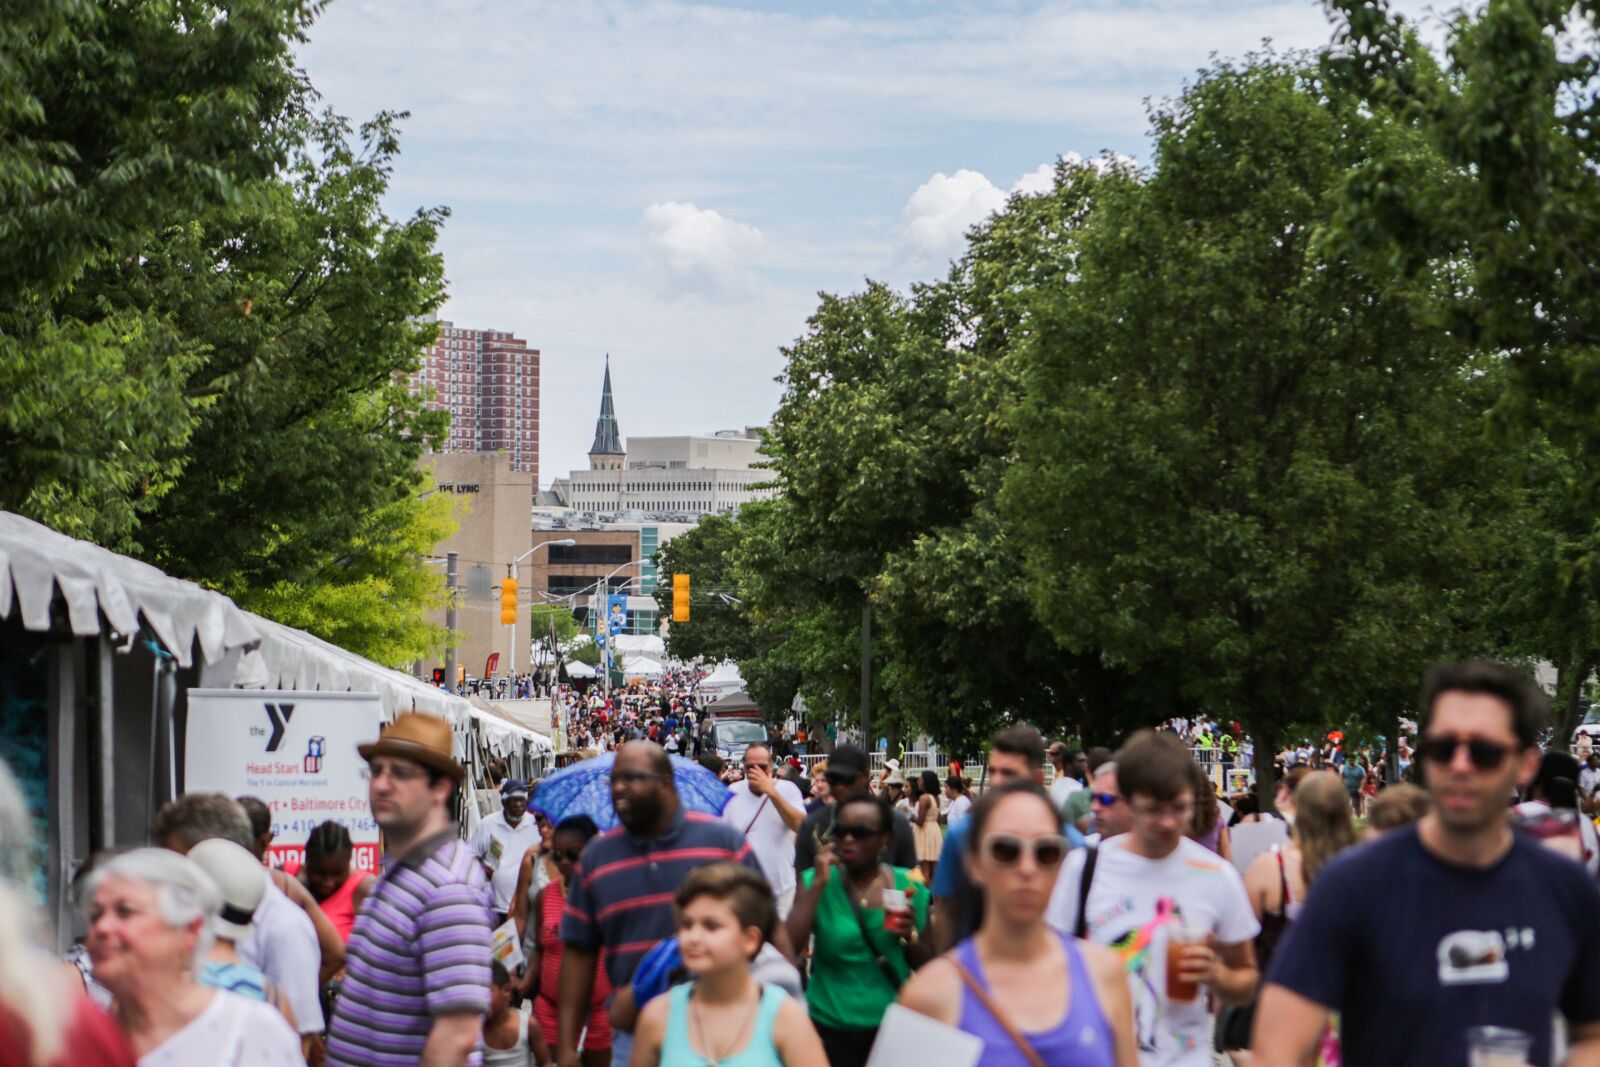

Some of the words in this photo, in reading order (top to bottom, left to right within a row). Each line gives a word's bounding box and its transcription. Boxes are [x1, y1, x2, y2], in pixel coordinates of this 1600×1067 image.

[457, 484, 479, 494] LYRIC
[249, 726, 266, 736] the
[264, 703, 295, 752] Y
[247, 763, 273, 774] Head
[275, 762, 299, 774] Start
[291, 797, 346, 811] Baltimore
[348, 796, 368, 813] City
